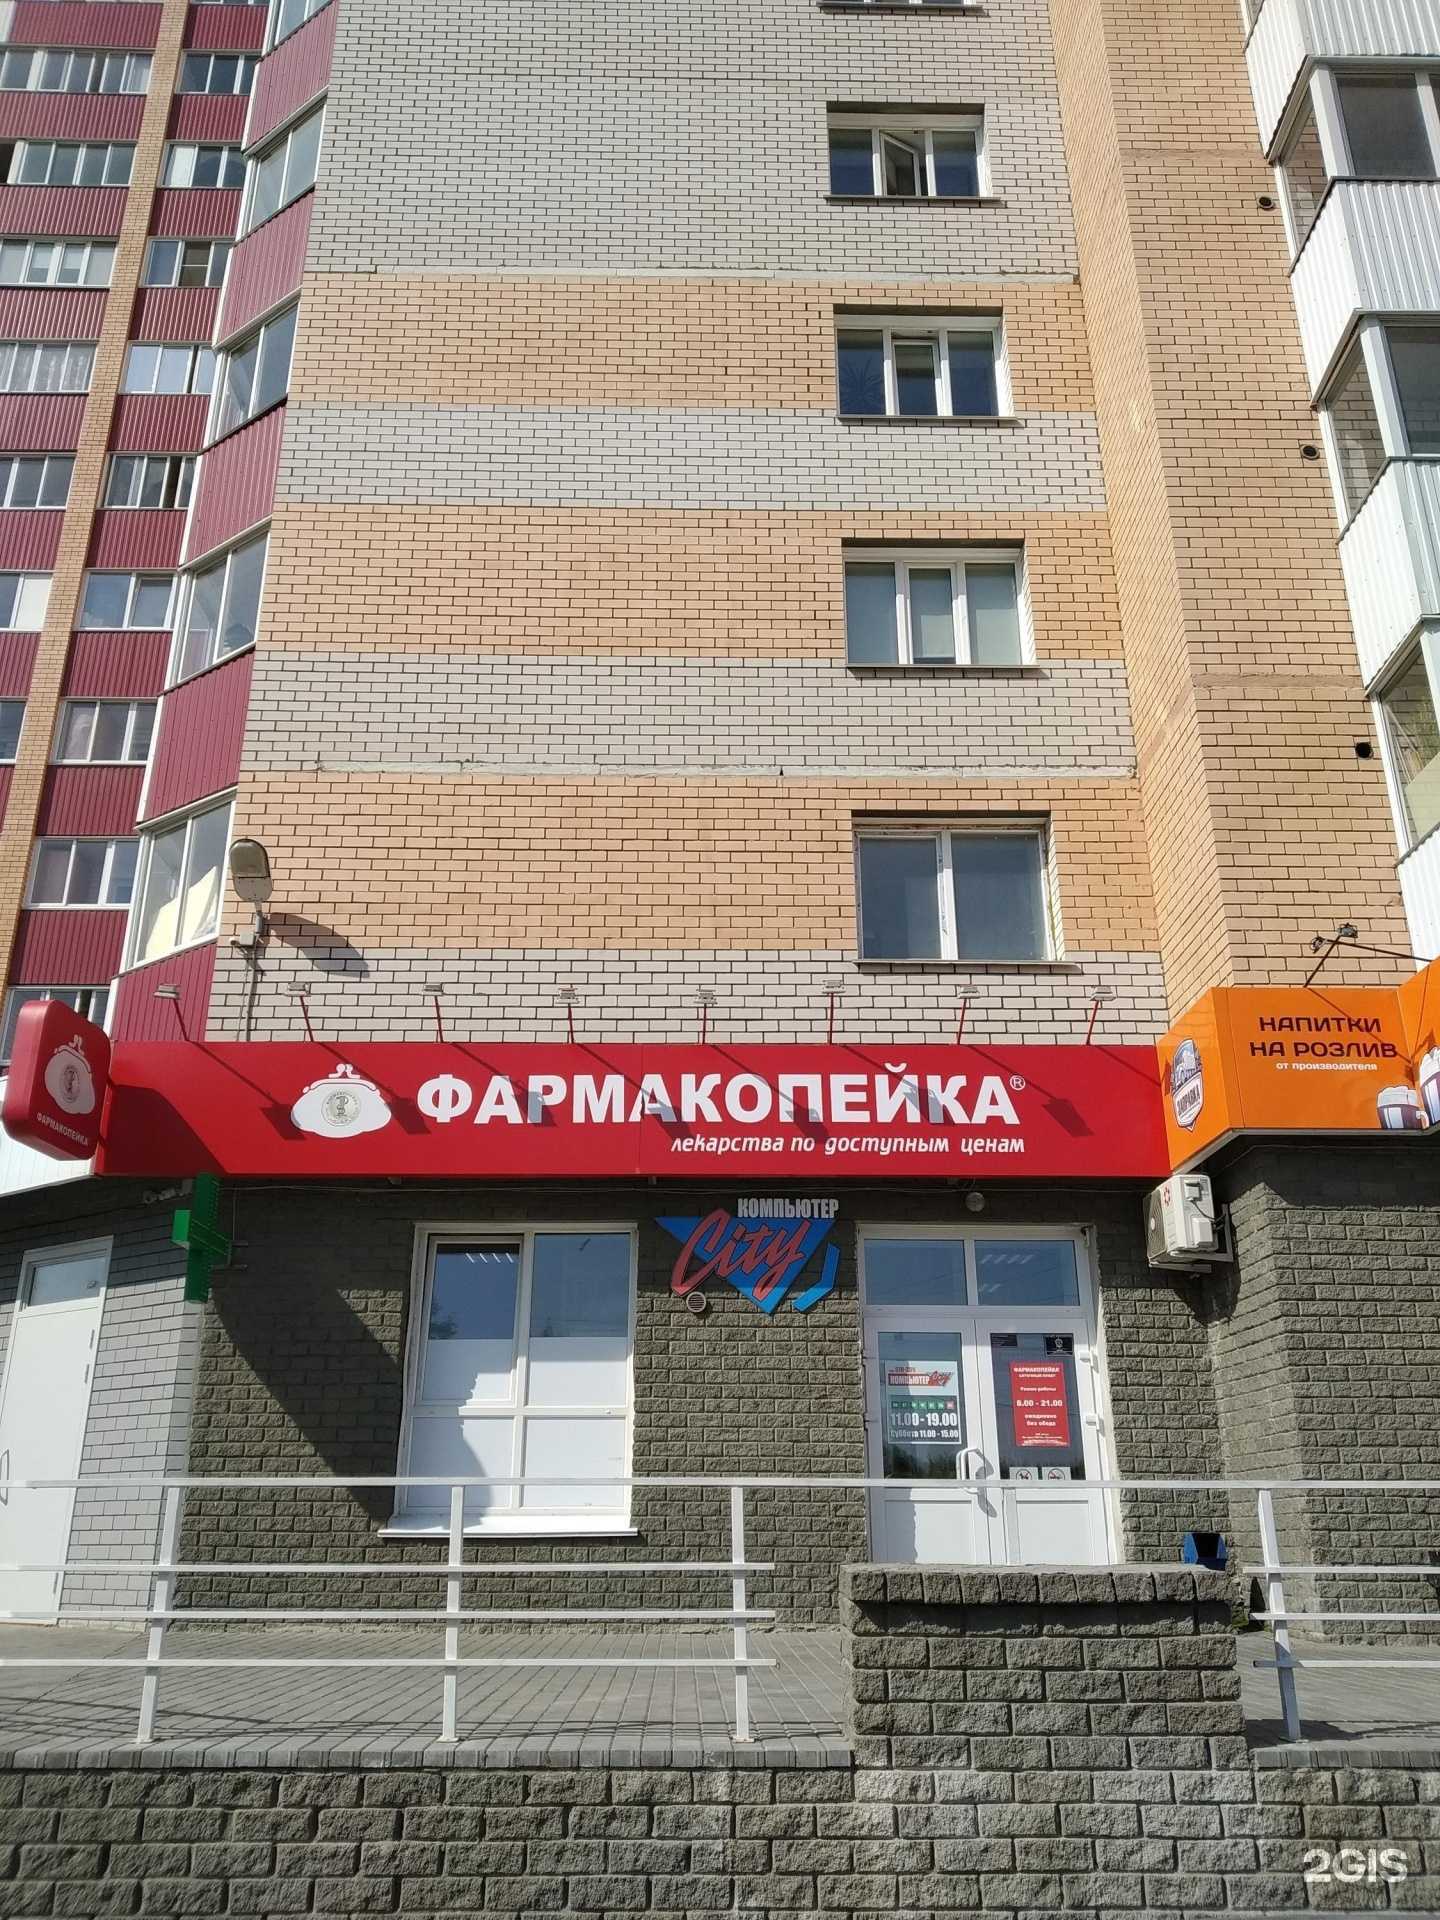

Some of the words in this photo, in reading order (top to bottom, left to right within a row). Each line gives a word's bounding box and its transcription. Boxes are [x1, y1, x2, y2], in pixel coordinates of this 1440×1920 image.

[1259, 1017, 1382, 1033] НАПИТКИ
[1249, 1041, 1285, 1057] НА
[1293, 1041, 1398, 1058] РОЗЛИВ
[1275, 1062, 1289, 1070] от
[1292, 1062, 1378, 1071] производителя
[416, 1062, 1021, 1125] ФАРМАКОПЕЙКА
[36, 1111, 89, 1147] ФАРМАКОПЕЙКА
[671, 1134, 784, 1154] лекарства
[790, 1137, 815, 1152] по
[824, 1137, 950, 1156] доступным
[960, 1137, 1025, 1156] ценам
[737, 1198, 840, 1219] КОМПЬЮТЕР
[671, 1208, 812, 1302] City
[889, 1375, 930, 1385] КОМПЬЮТЕР
